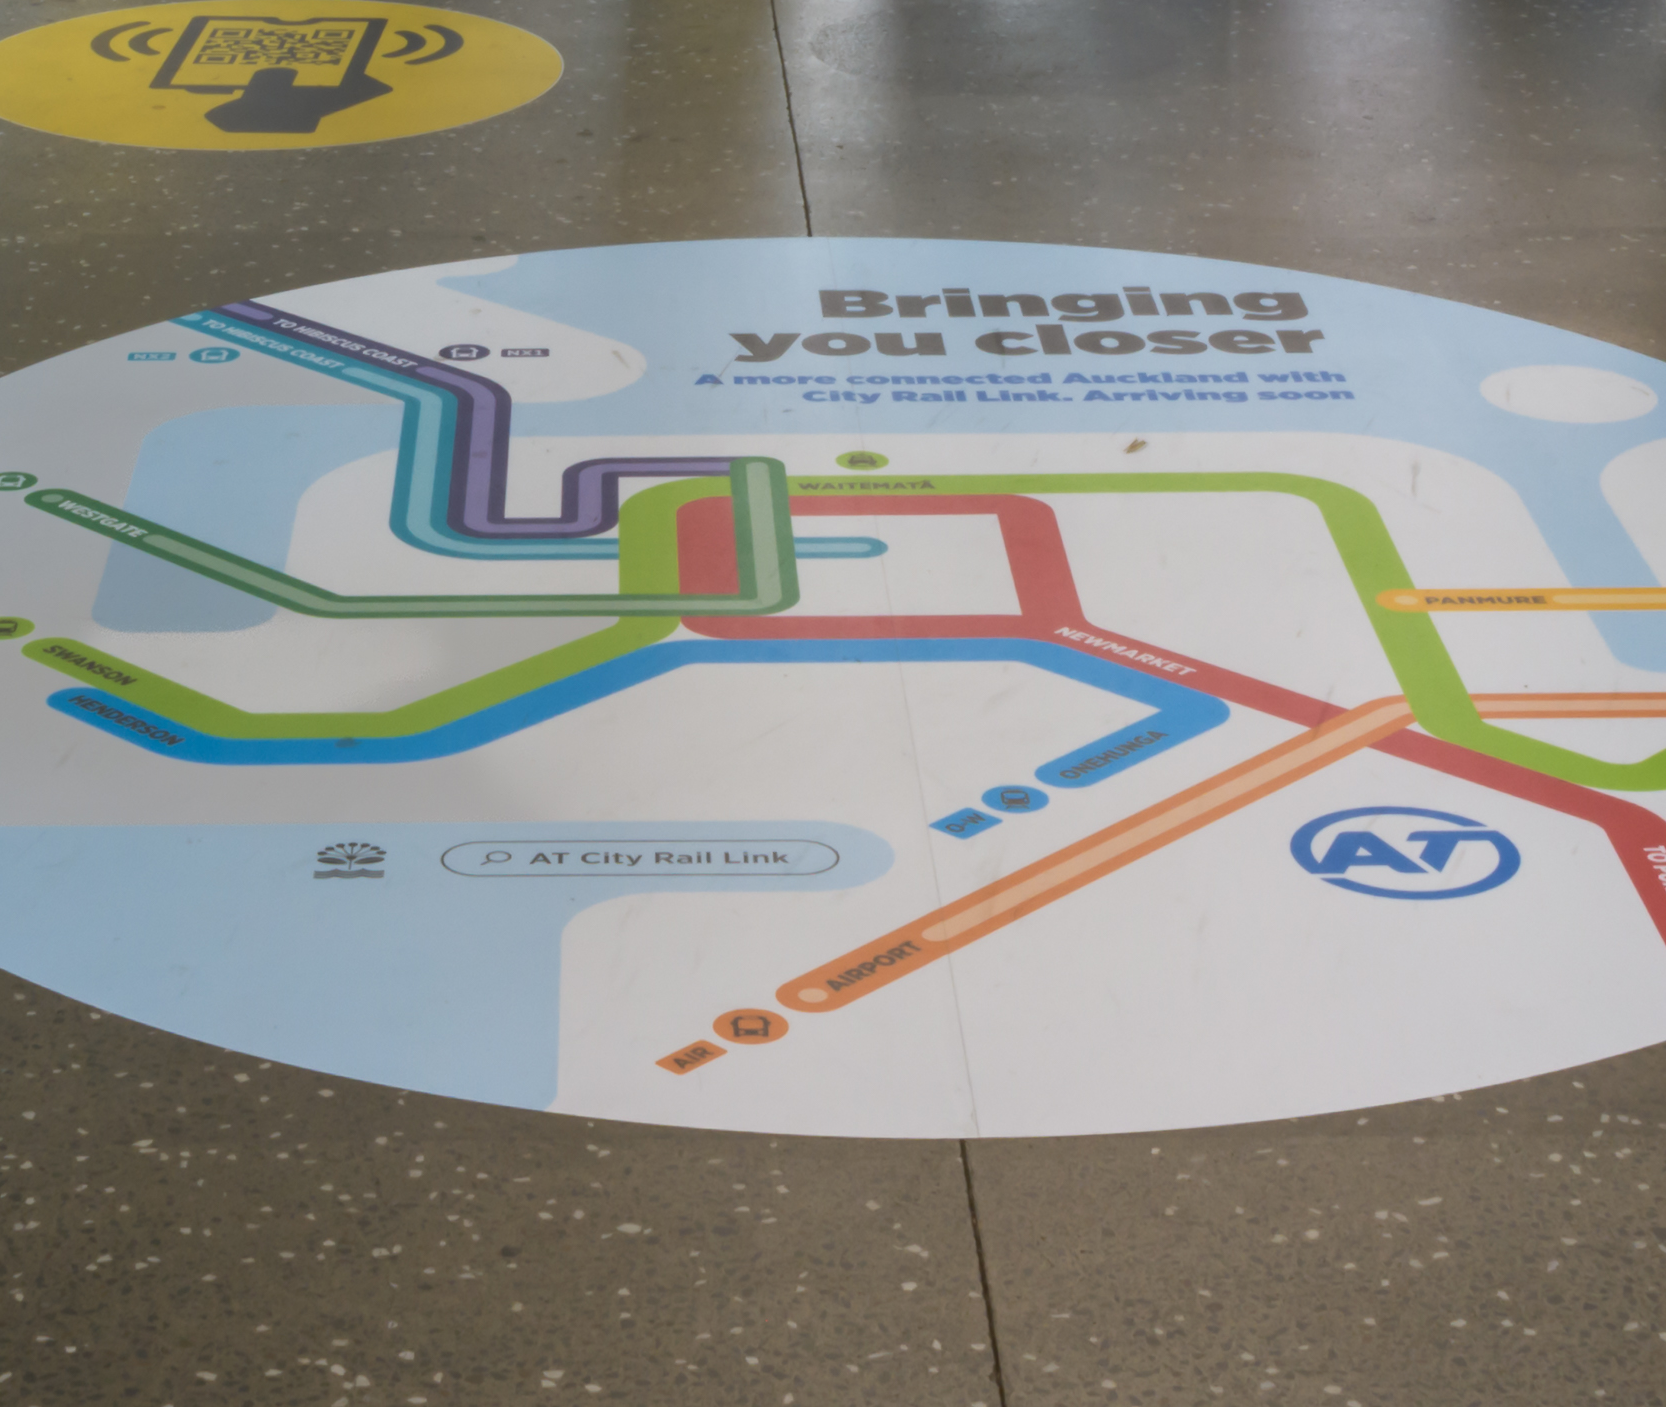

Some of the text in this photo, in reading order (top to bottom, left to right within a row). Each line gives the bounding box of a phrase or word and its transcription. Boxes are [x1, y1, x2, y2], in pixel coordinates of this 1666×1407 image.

[818, 286, 1309, 323] Bringing
[134, 353, 173, 361] NX2
[203, 319, 345, 370] TO HIBISCUS COAST
[273, 318, 418, 369] TO HIBISCUS COAST
[507, 348, 548, 357] NX1
[728, 324, 1325, 362] you closer
[694, 371, 1347, 385] A more connected Auckland with
[802, 389, 1355, 404] City Rail Link. Arriving soon
[58, 500, 149, 538] WESTGATE
[1424, 595, 1548, 606] PANMURE
[43, 645, 137, 686] SWANSON
[1054, 627, 1197, 676] NEWMARKET
[67, 694, 185, 746] HENDERSON
[1059, 730, 1169, 780] ONEHUNGA
[945, 812, 987, 834] O-W
[529, 850, 789, 868] AT City Rail Link
[826, 940, 922, 992] AIRPORT
[673, 1046, 714, 1070] AIR
